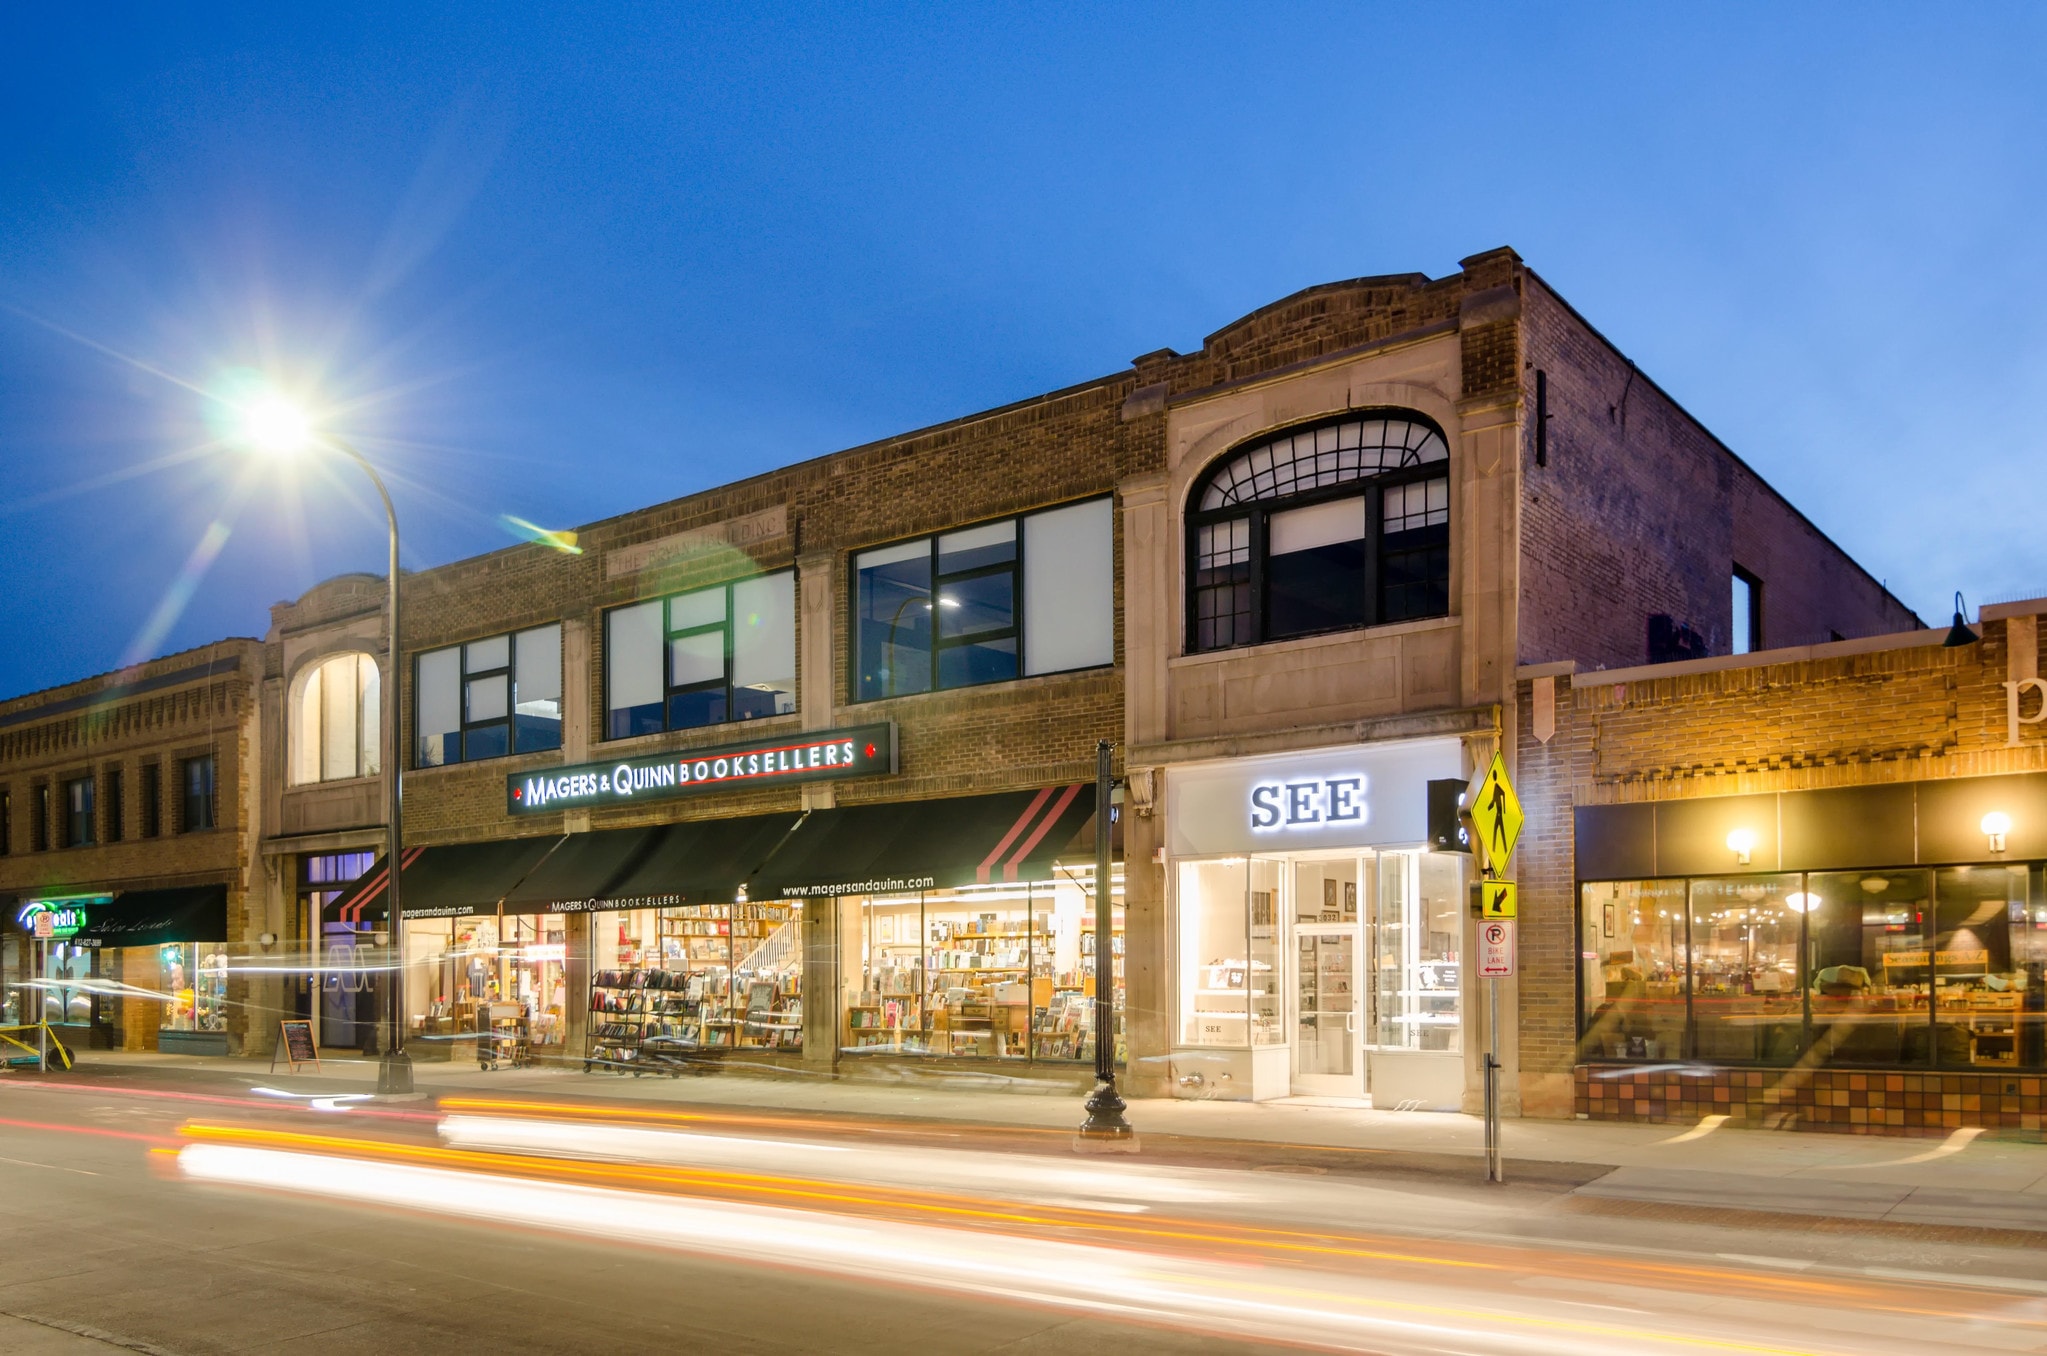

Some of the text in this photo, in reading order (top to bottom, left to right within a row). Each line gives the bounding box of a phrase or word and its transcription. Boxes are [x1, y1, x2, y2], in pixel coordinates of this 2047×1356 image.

[616, 552, 641, 571] THE
[525, 741, 854, 806] MAGERS & QUINN BOOKSELLERS
[1251, 778, 1361, 828] SEE
[782, 876, 934, 896] www.magersandquinn.com
[551, 900, 582, 912] MAGERS
[588, 897, 614, 910] QUINN
[1487, 947, 1504, 955] BIKE
[1887, 953, 1958, 964] Seasonngs
[1205, 1025, 1222, 1033] SEE
